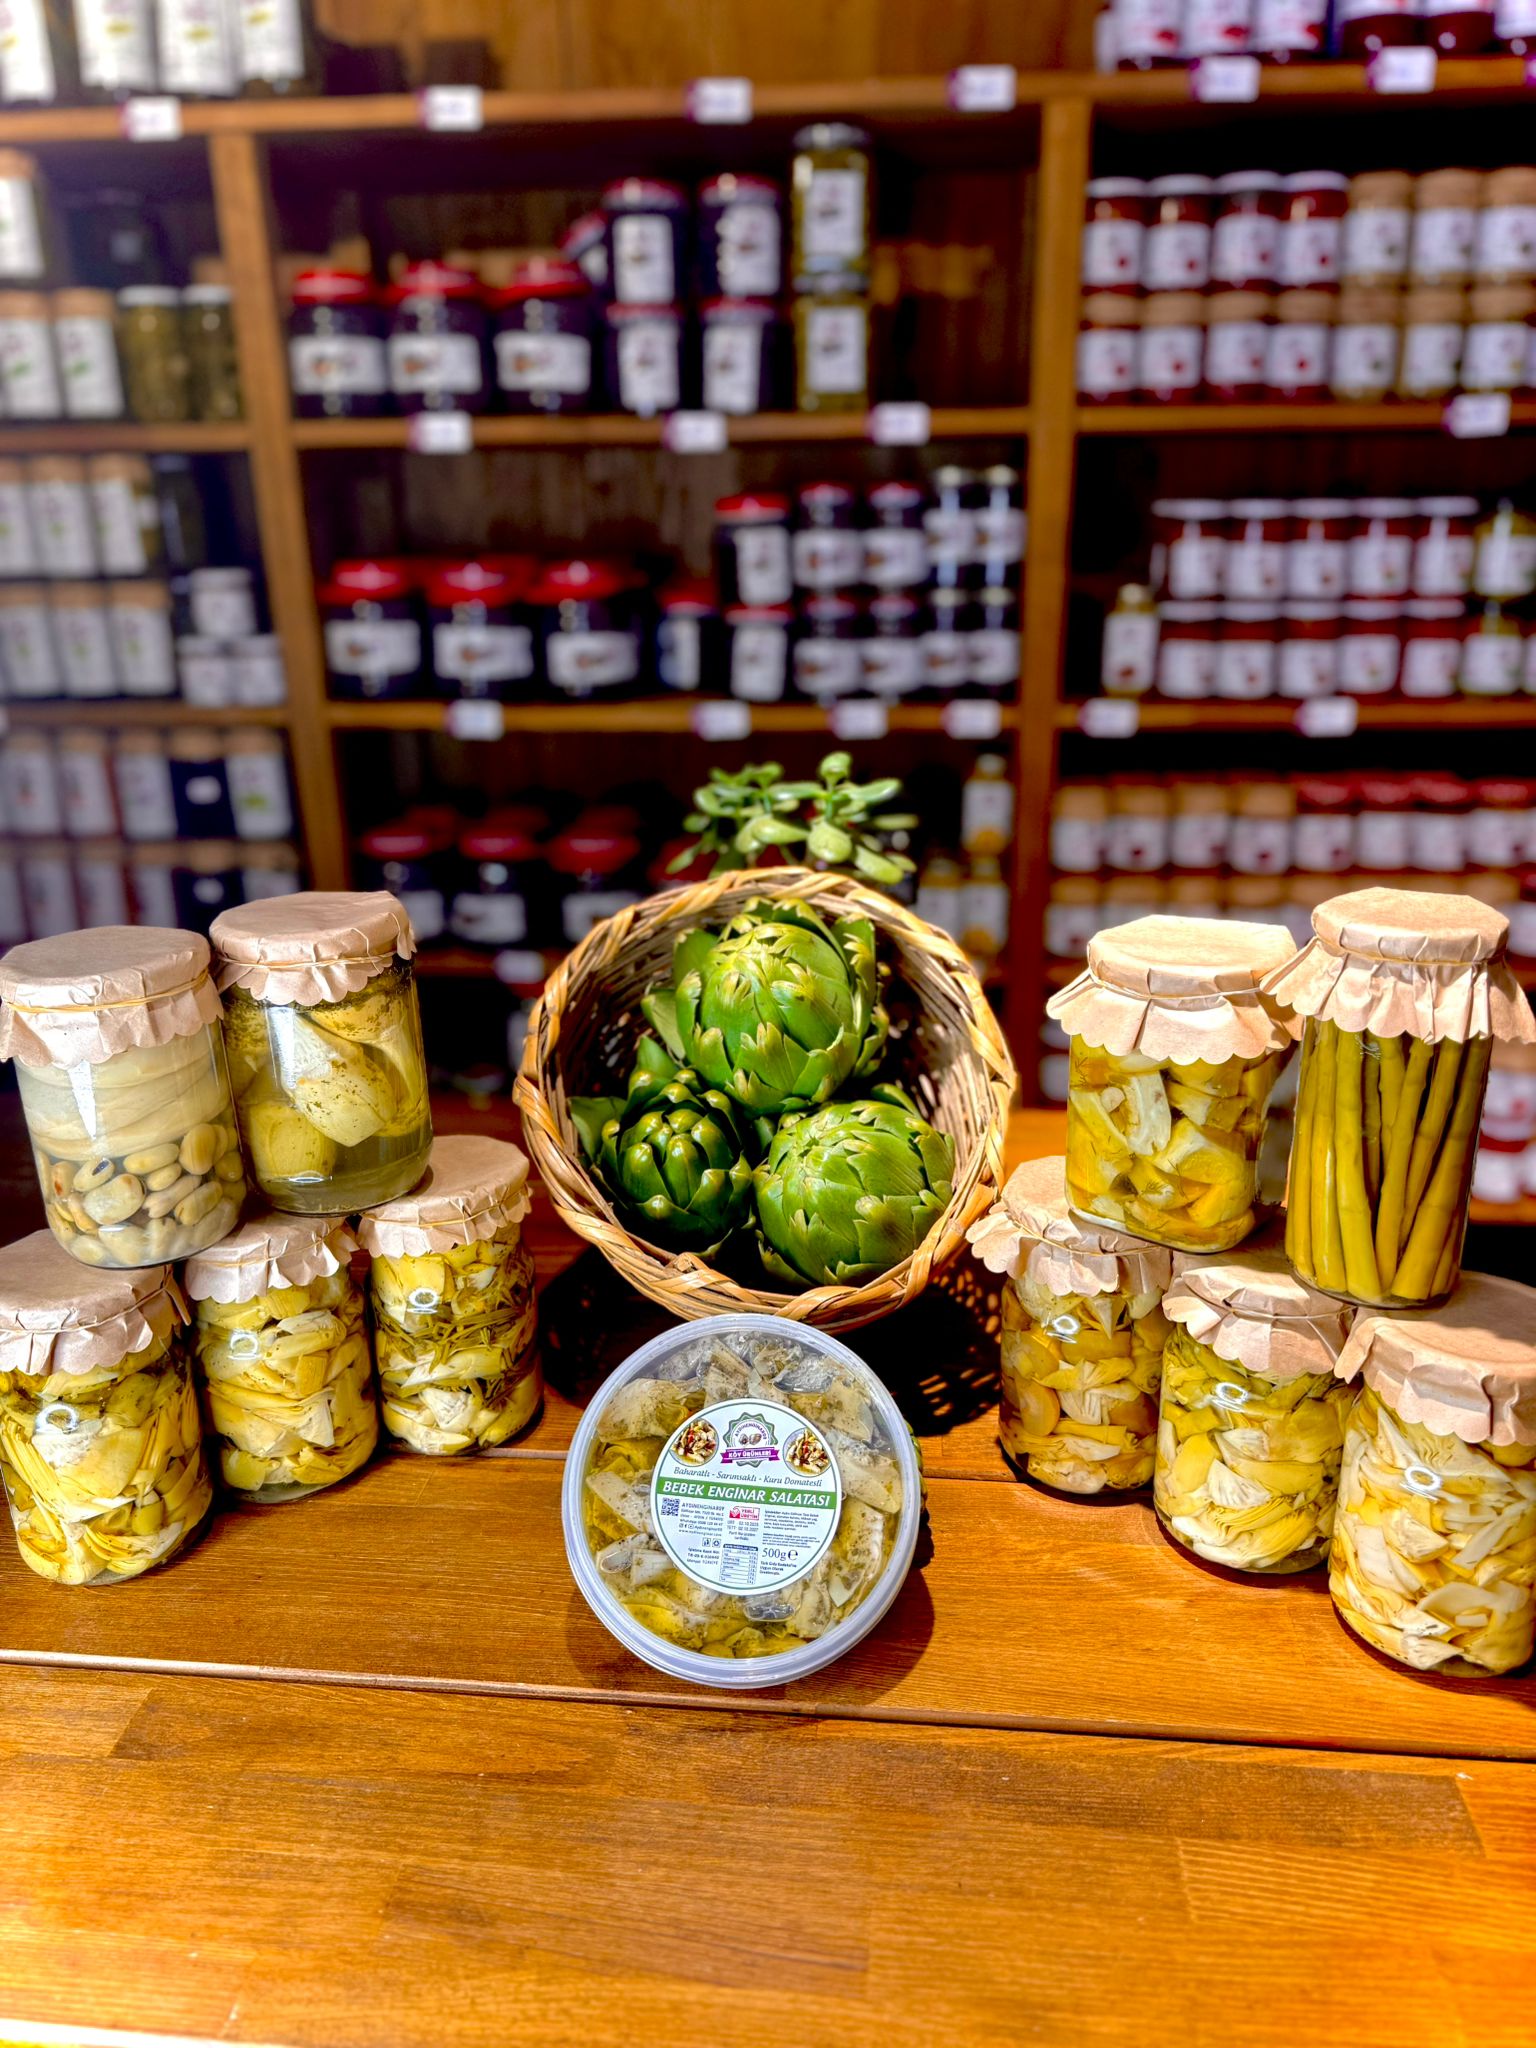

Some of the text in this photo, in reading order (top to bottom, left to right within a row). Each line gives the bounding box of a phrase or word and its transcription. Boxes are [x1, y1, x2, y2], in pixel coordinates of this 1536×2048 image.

[674, 1466, 710, 1478] Baharatlı
[716, 1470, 757, 1482] Sarımsaklı
[764, 1476, 782, 1485] Kuru
[784, 1476, 822, 1487] Domatesli
[663, 1481, 831, 1506] BEBEK ENGİNAR SALATASI
